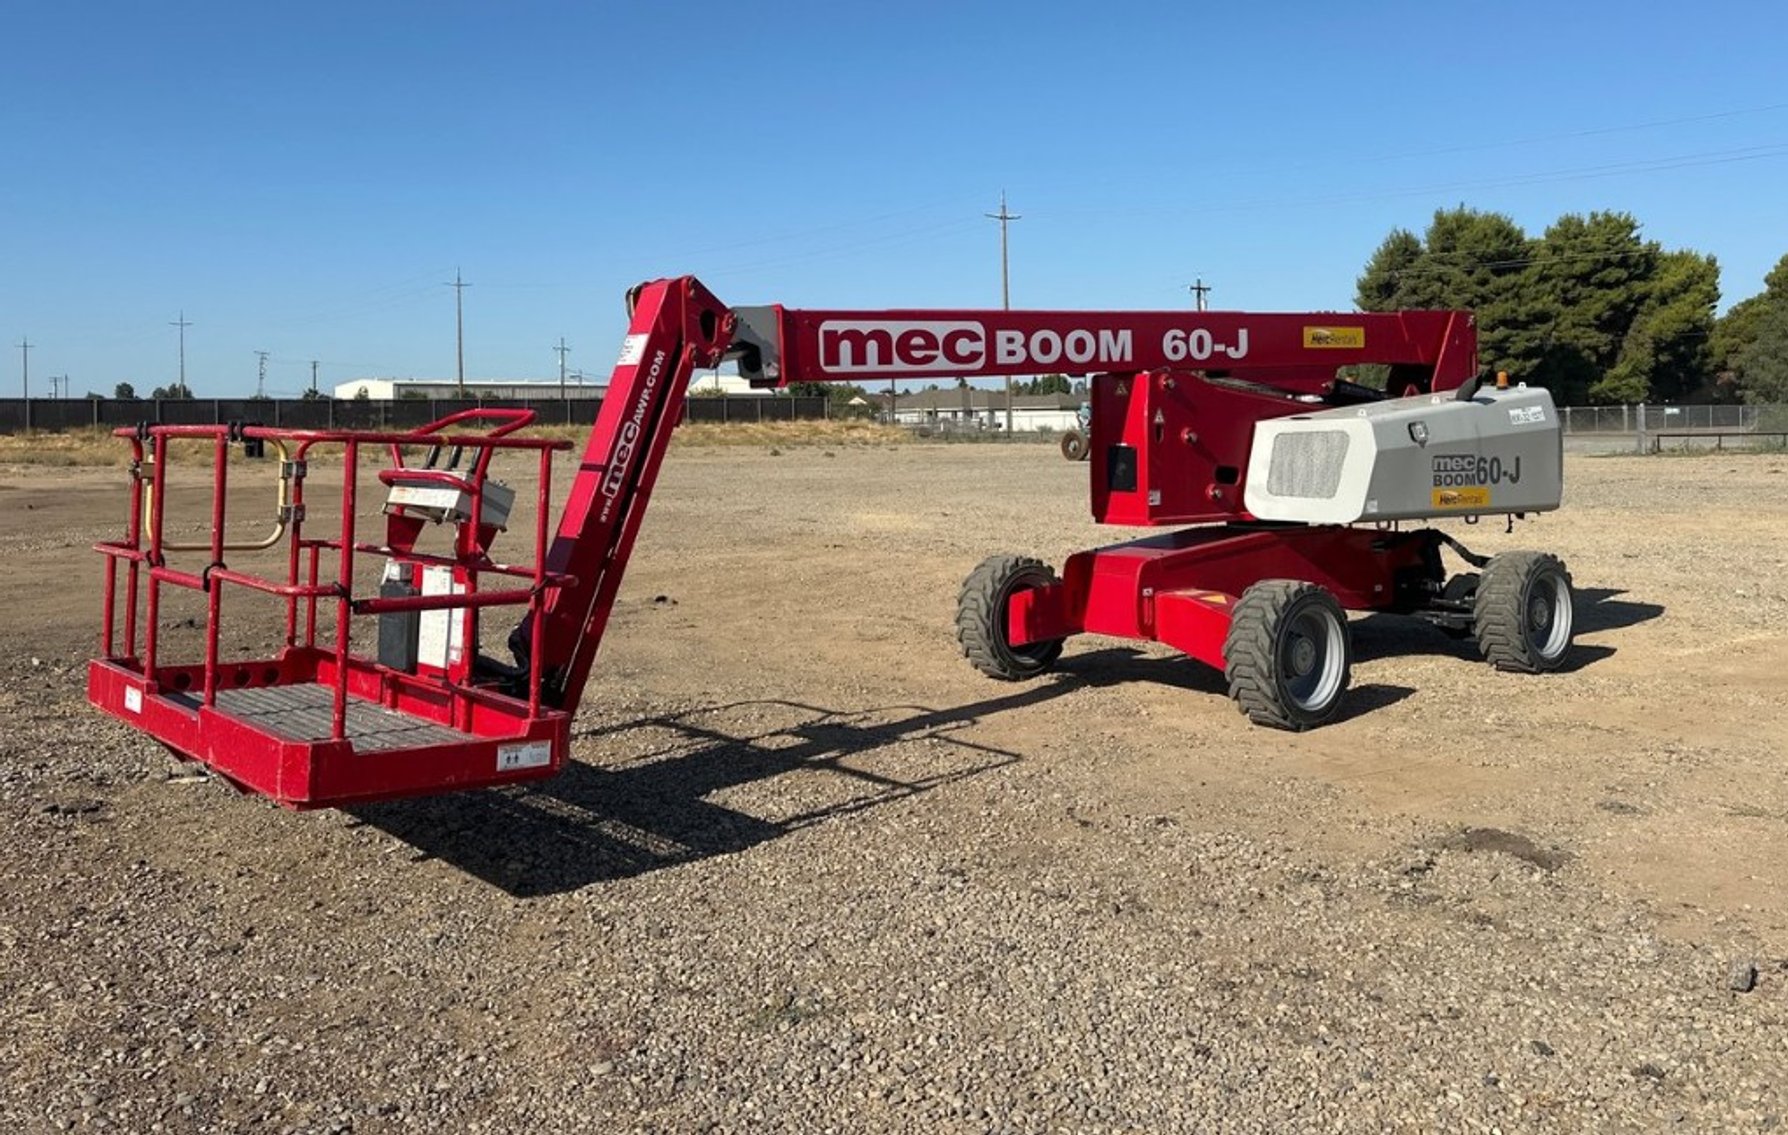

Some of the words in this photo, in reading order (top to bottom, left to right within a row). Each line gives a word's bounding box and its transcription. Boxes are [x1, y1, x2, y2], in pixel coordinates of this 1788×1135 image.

[822, 327, 985, 367] mec
[995, 329, 1133, 364] BOOM
[1162, 328, 1249, 361] 60-J
[1432, 455, 1476, 472] mec
[1476, 456, 1521, 485] 60-J
[1433, 473, 1476, 487] BOOM
